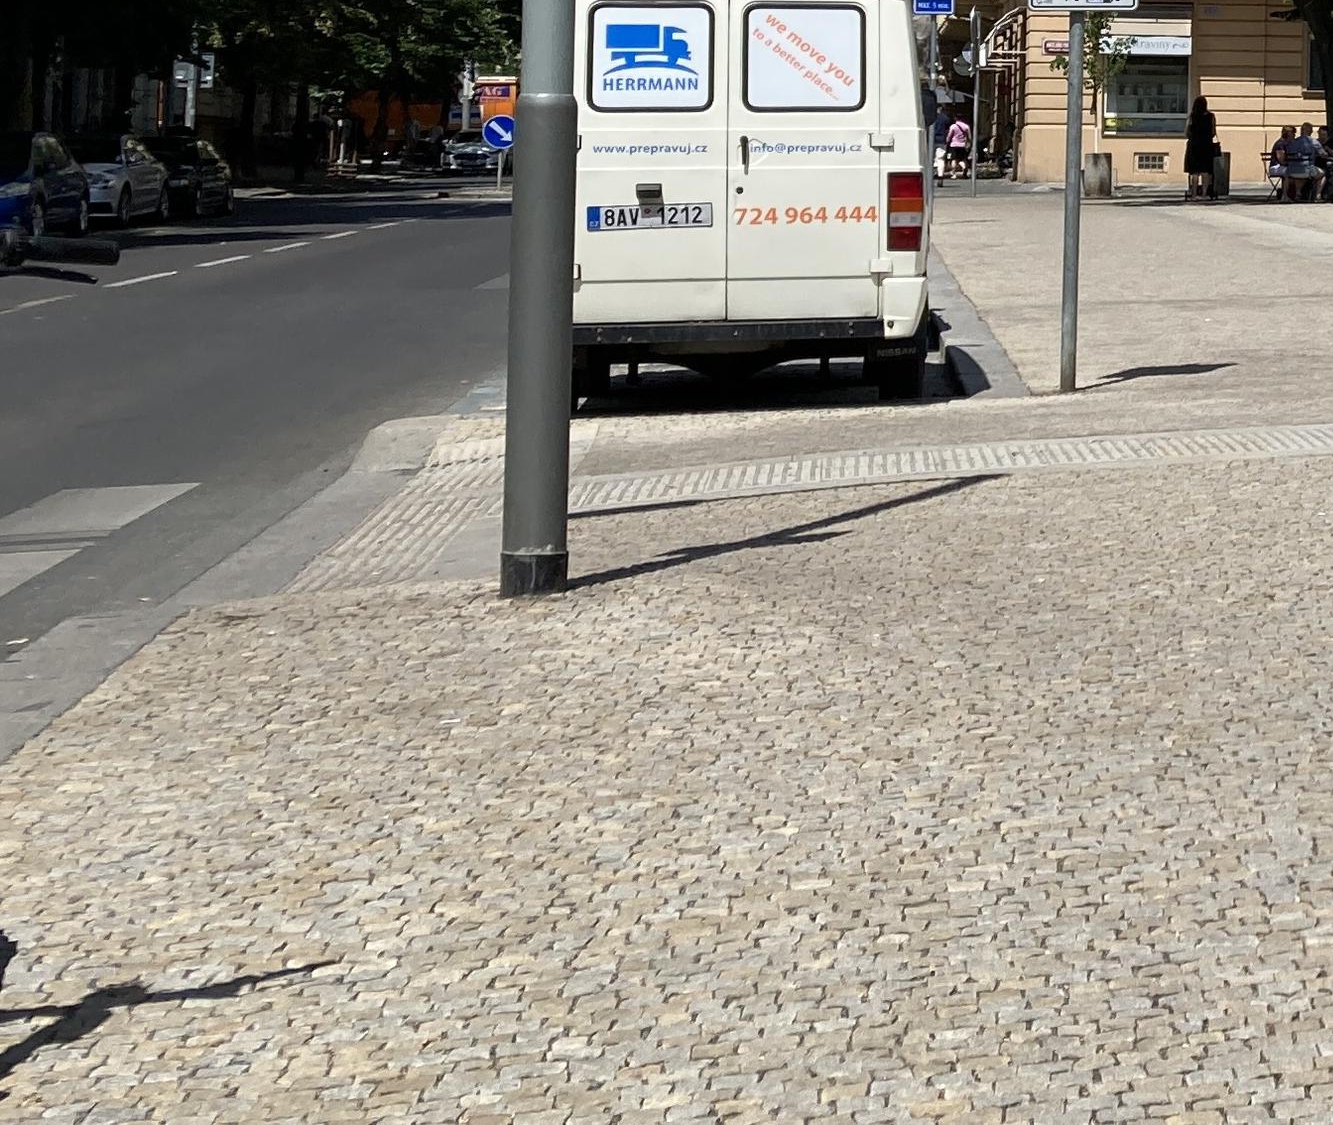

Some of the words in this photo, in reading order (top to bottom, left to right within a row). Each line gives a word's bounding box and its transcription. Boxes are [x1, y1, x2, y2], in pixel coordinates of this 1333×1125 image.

[752, 28, 765, 40] to
[772, 43, 806, 71] better
[766, 15, 787, 34] we
[786, 32, 826, 65] move
[824, 63, 855, 87] you
[603, 78, 698, 91] HERRMANN
[593, 143, 708, 155] www.prepravuj.cz
[750, 143, 862, 154] info@prepravuj.cz
[604, 209, 640, 227] 8AV
[656, 206, 702, 225] 1212
[734, 207, 778, 225] 724
[785, 207, 828, 224] 964
[834, 206, 878, 223] 444
